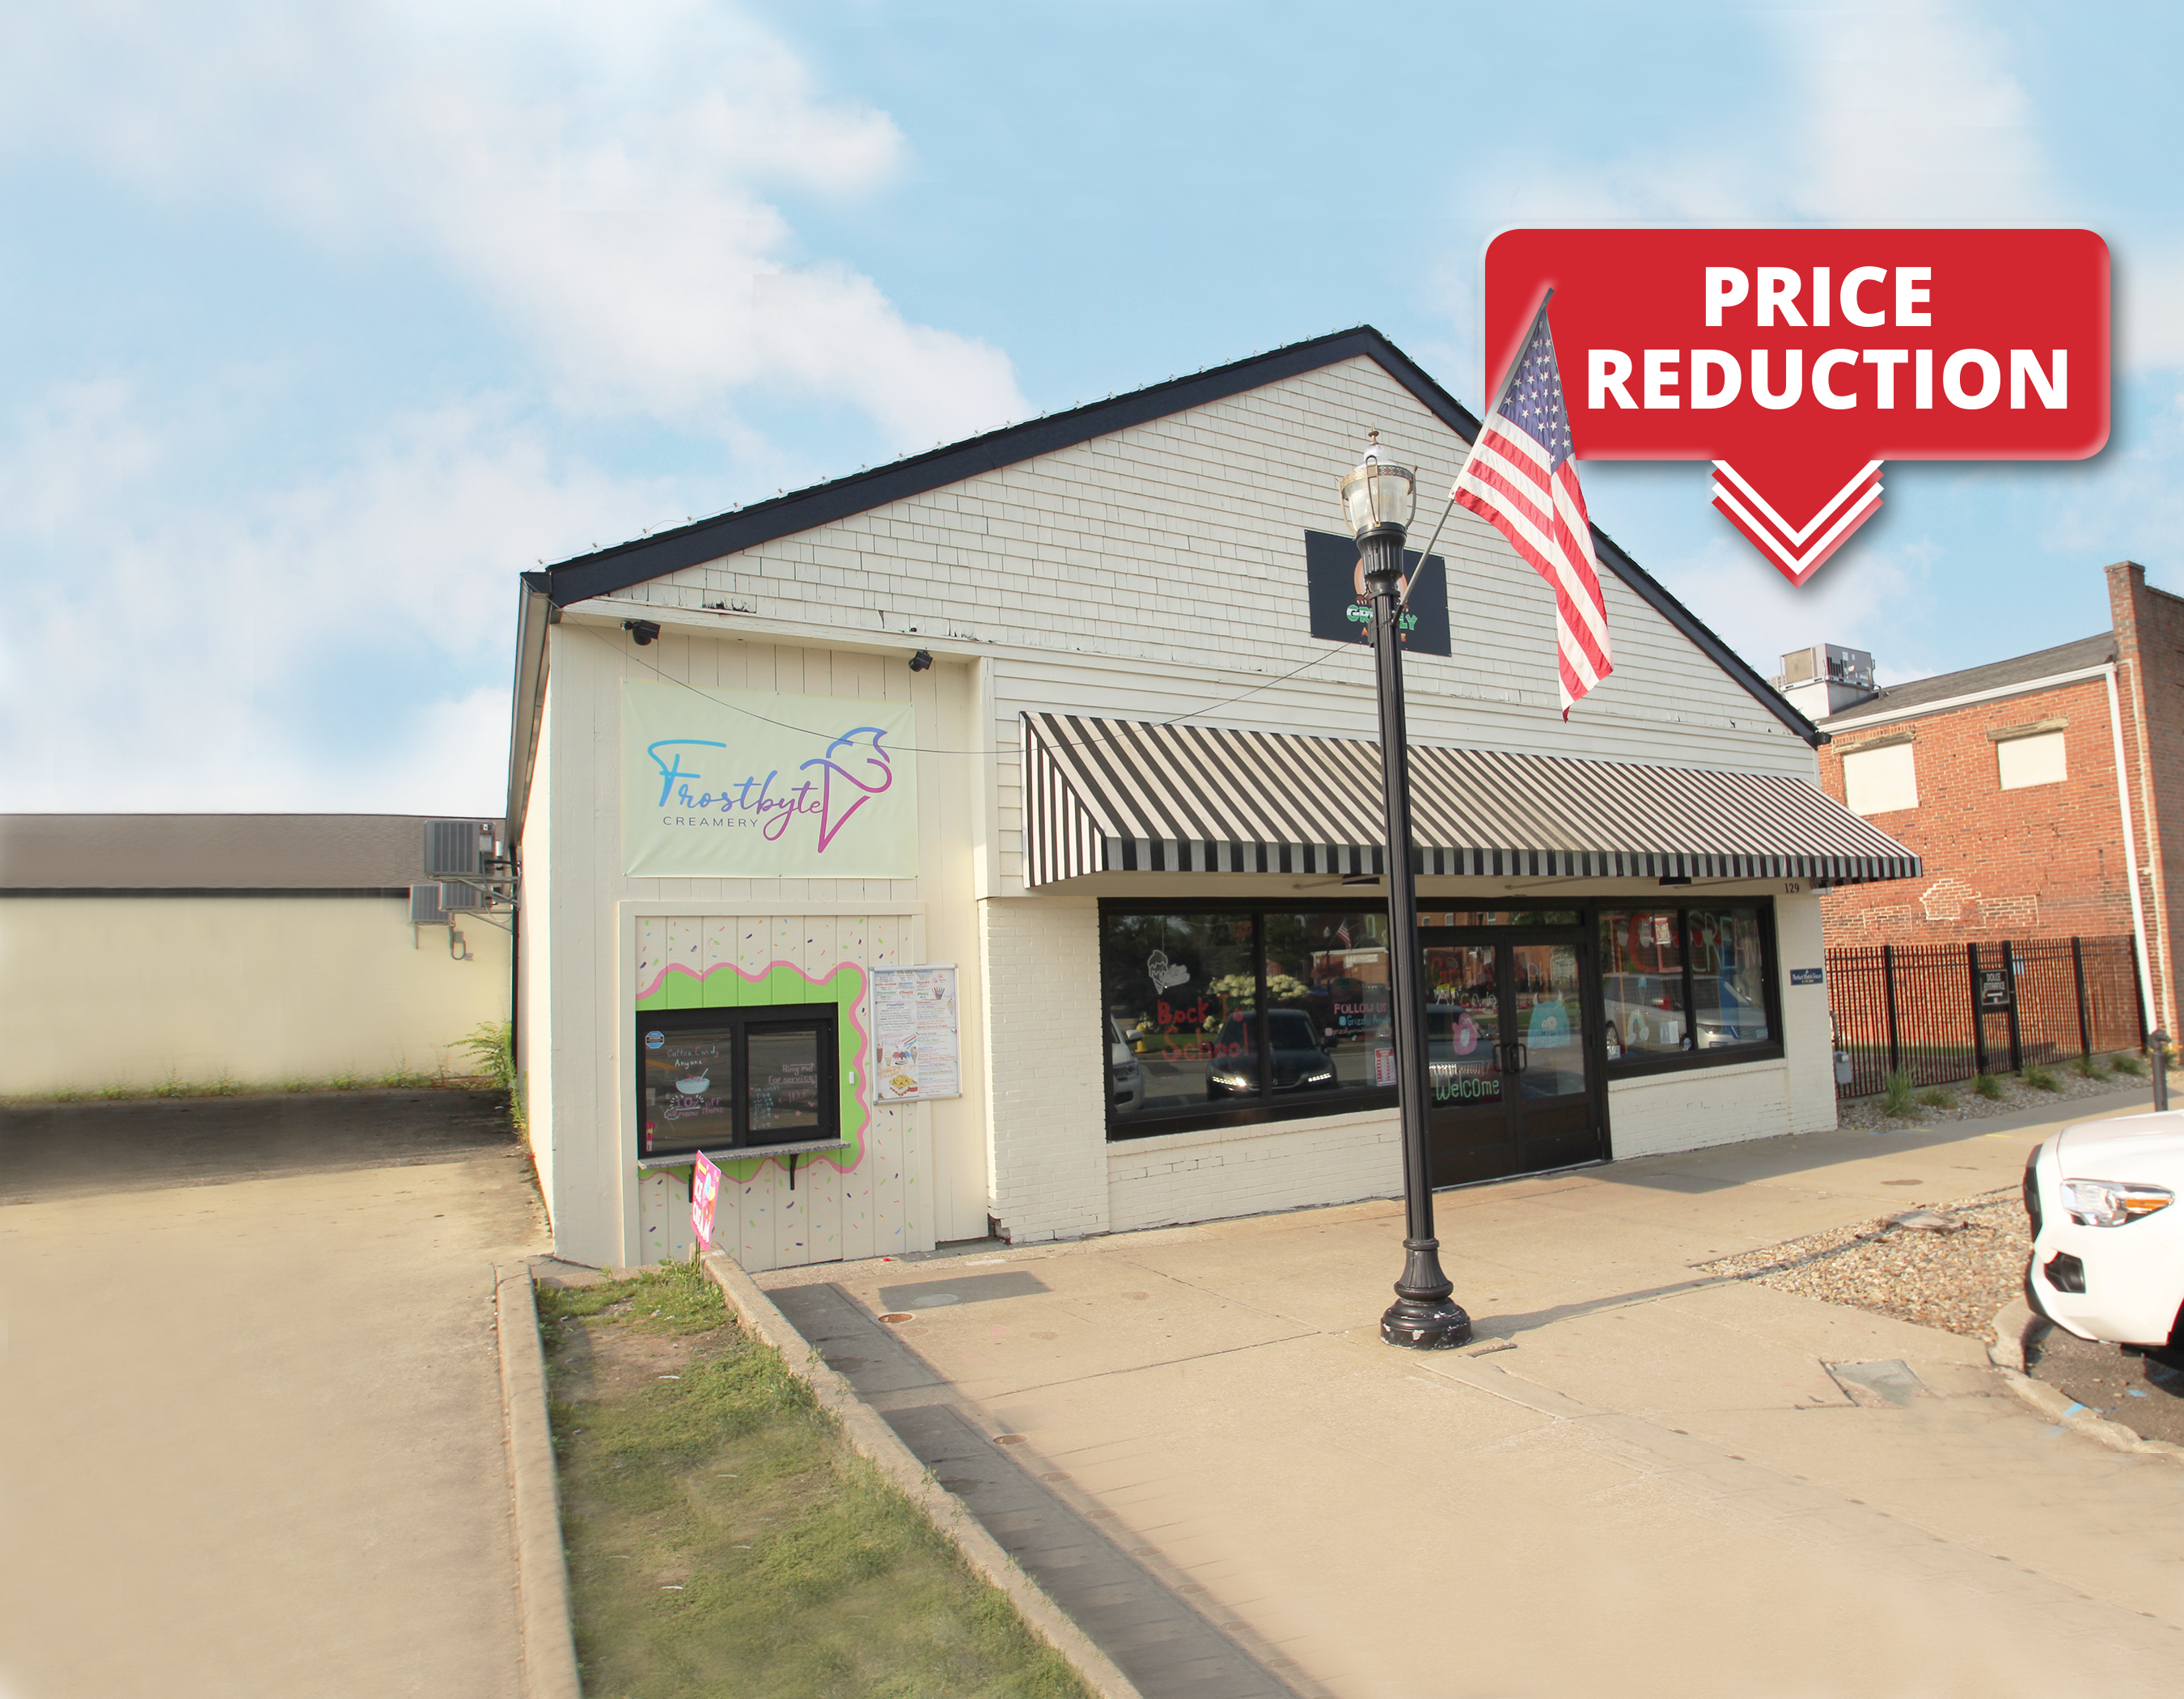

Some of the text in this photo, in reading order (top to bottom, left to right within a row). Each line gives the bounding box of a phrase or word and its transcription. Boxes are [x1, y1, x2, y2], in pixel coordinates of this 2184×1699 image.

[648, 739, 824, 841] Frostbyte
[663, 816, 759, 827] CREAMERY
[1784, 883, 1800, 893] 129
[1987, 972, 2001, 981] DOLCE
[1983, 981, 2005, 991] ENTRANCE
[1216, 994, 1244, 1023] To
[1334, 1002, 1388, 1015] FOLLOW US
[1346, 1014, 1371, 1027] Grizzly
[1162, 1023, 1250, 1061] School
[667, 1046, 719, 1058] Cotton Candy
[782, 1064, 799, 1076] Ring
[768, 1074, 814, 1083] for service
[1436, 1074, 1500, 1100] Welcome
[675, 1097, 722, 1108] 10% off
[702, 1107, 724, 1115] items
[694, 1175, 703, 1205] ICE
